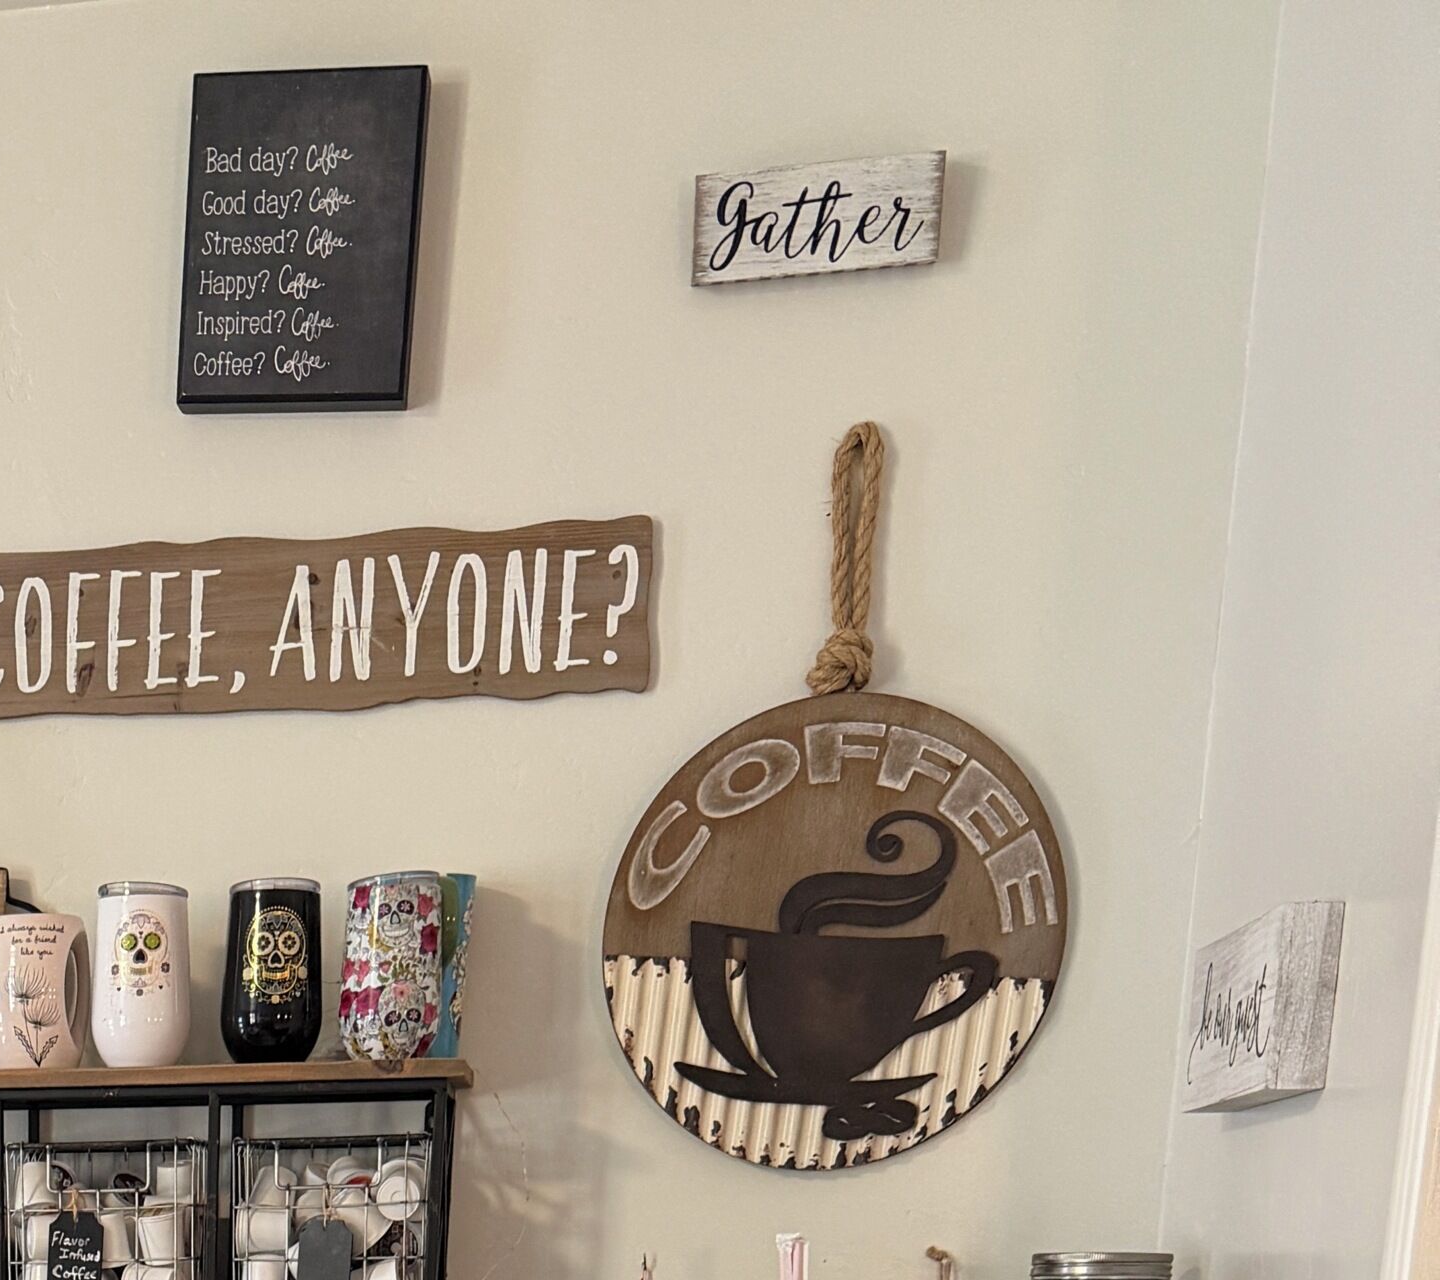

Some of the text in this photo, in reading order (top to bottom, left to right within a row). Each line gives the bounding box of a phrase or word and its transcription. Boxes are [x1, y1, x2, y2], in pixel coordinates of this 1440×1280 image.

[205, 146, 242, 174] Bad
[250, 146, 299, 177] day?
[202, 189, 247, 216] Good
[254, 189, 303, 219] day?
[201, 229, 299, 255] Stressed?
[199, 269, 270, 301] Happy?
[196, 310, 286, 341] Inspired?
[193, 351, 266, 377] Coffee?
[269, 544, 640, 683] ANYONE?
[628, 721, 1058, 934] COFFEE
[7, 923, 37, 935] always
[11, 936, 23, 945] for
[34, 934, 57, 944] friend
[20, 947, 53, 960] like you
[51, 1230, 90, 1247] Flavor
[59, 1247, 101, 1263] Infused
[52, 1264, 97, 1280] Coffee
